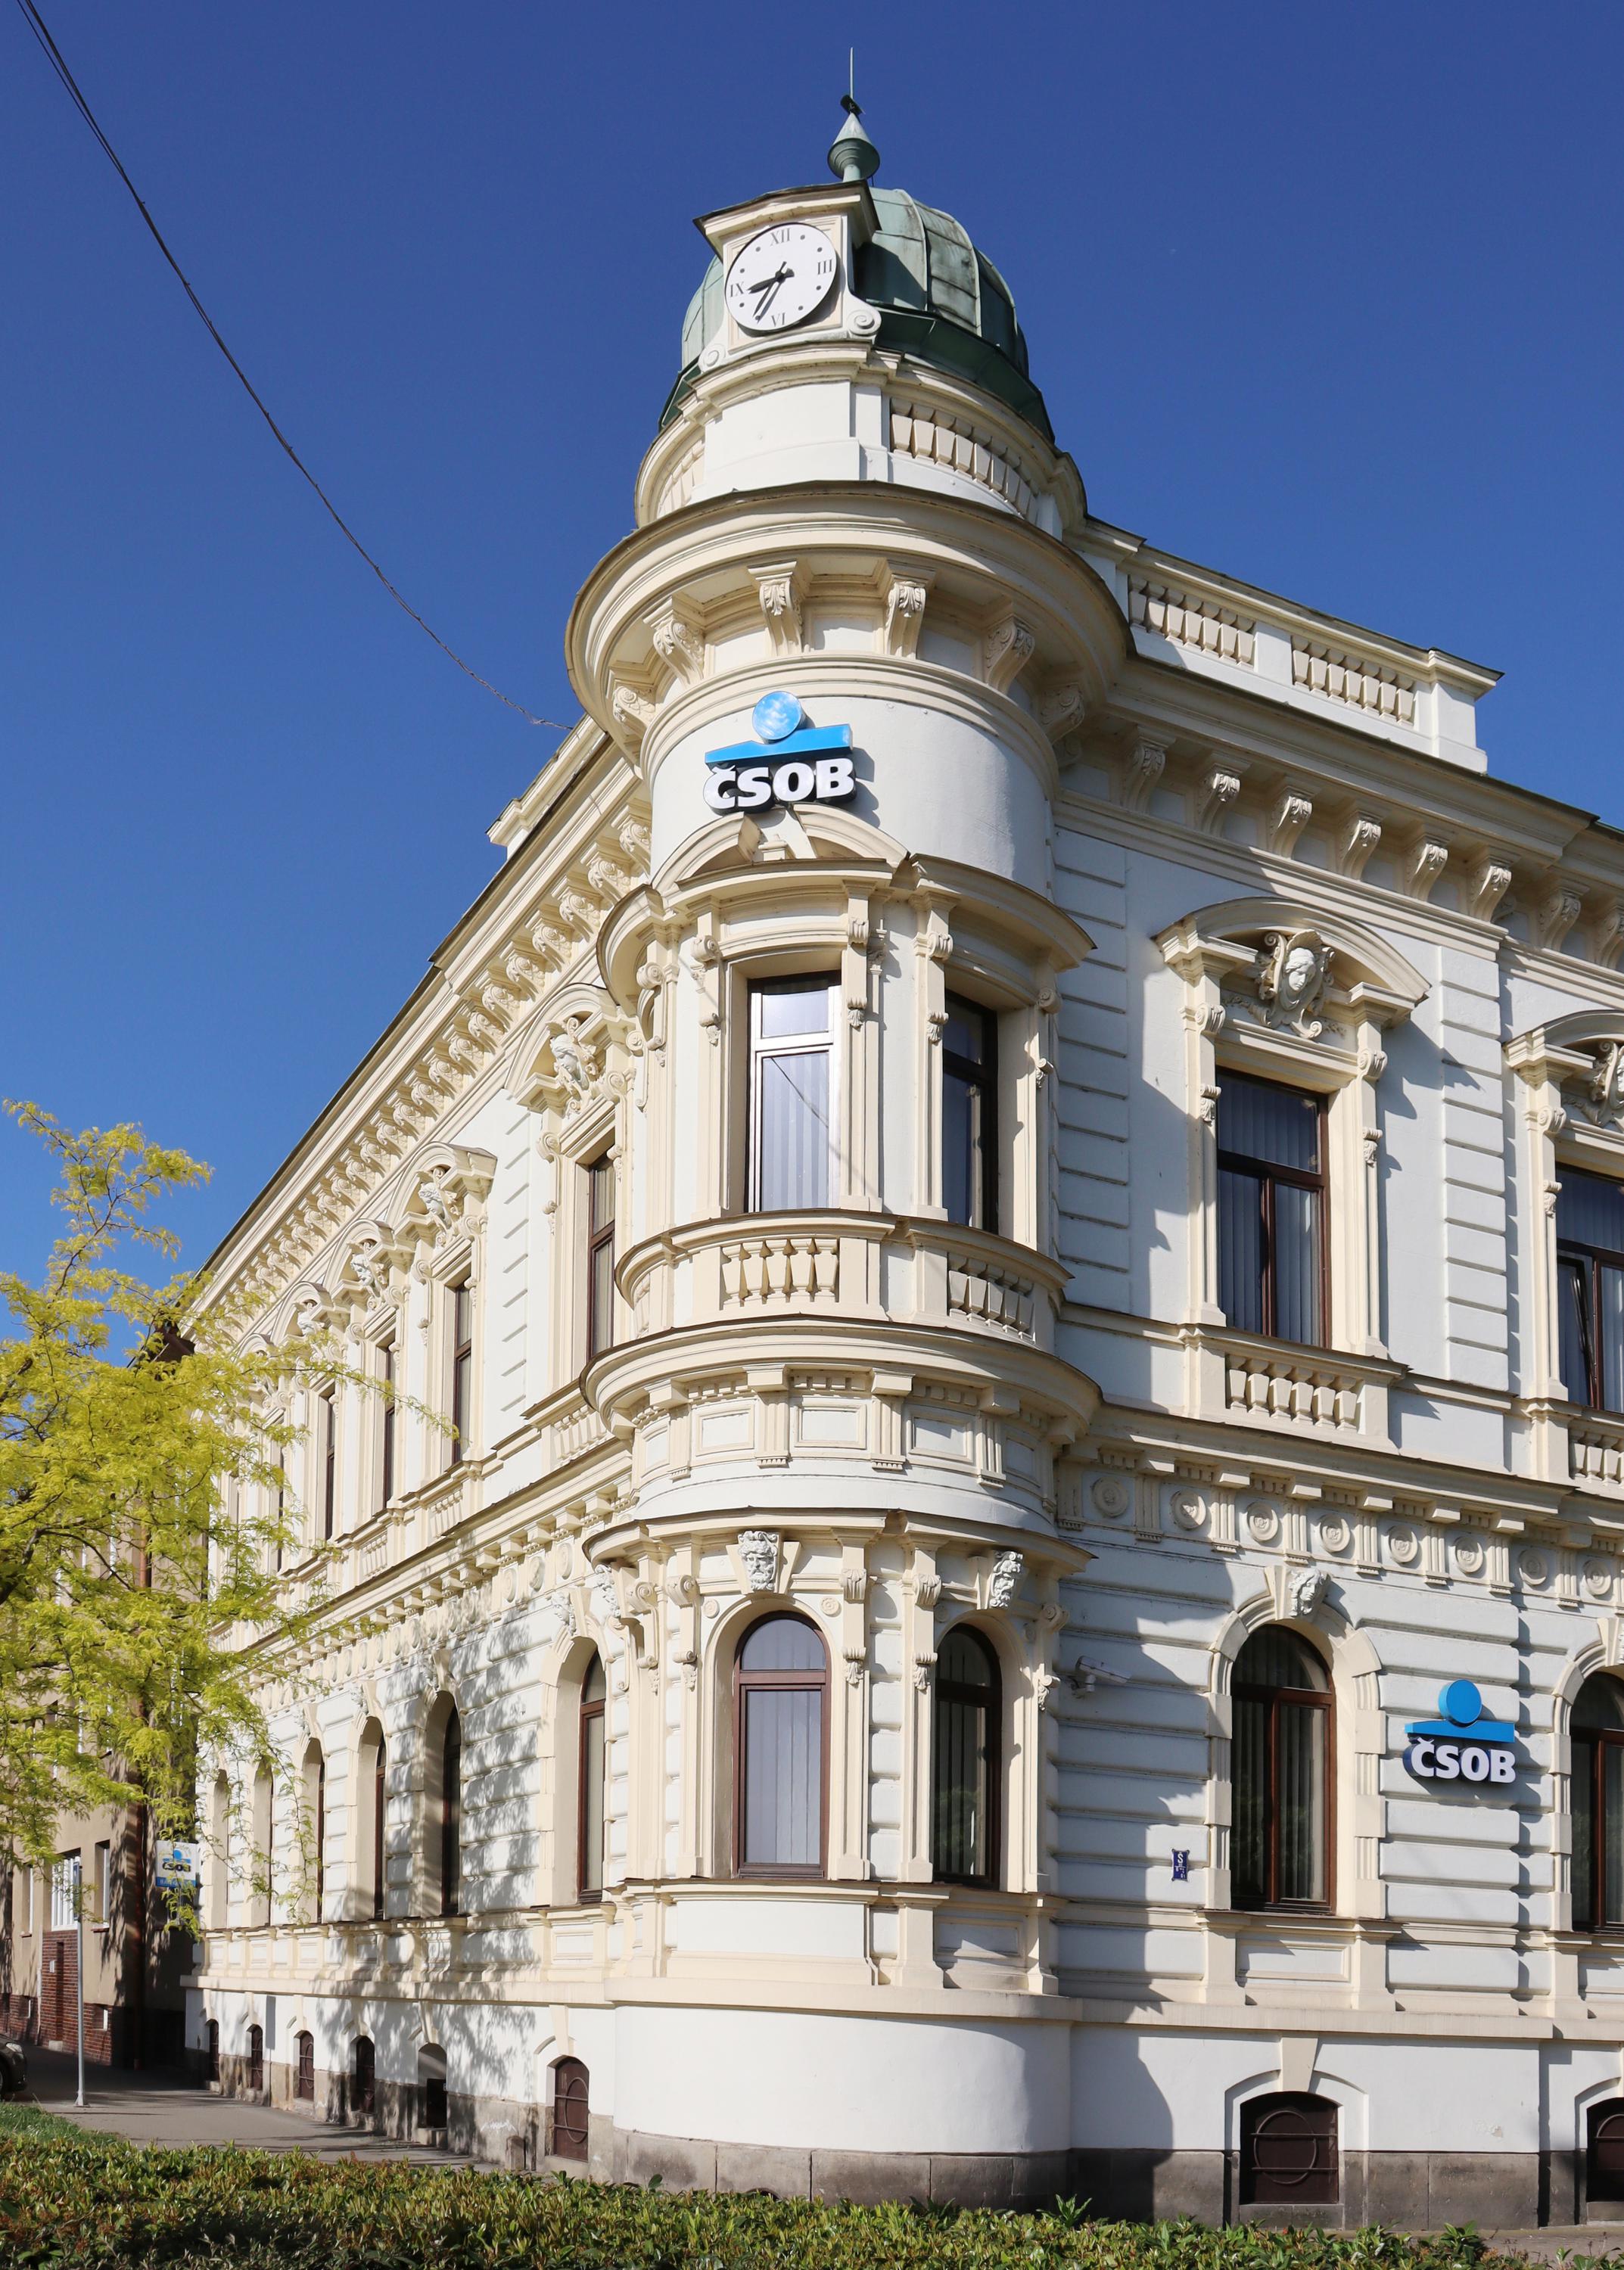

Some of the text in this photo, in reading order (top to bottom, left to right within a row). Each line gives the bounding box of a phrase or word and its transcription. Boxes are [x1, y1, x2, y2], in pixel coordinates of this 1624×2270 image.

[770, 229, 790, 246] XII
[817, 260, 832, 275] III
[730, 281, 745, 297] IX
[771, 313, 786, 327] VI
[704, 758, 854, 809] ČSOB
[1411, 1737, 1516, 1783] ČSOB
